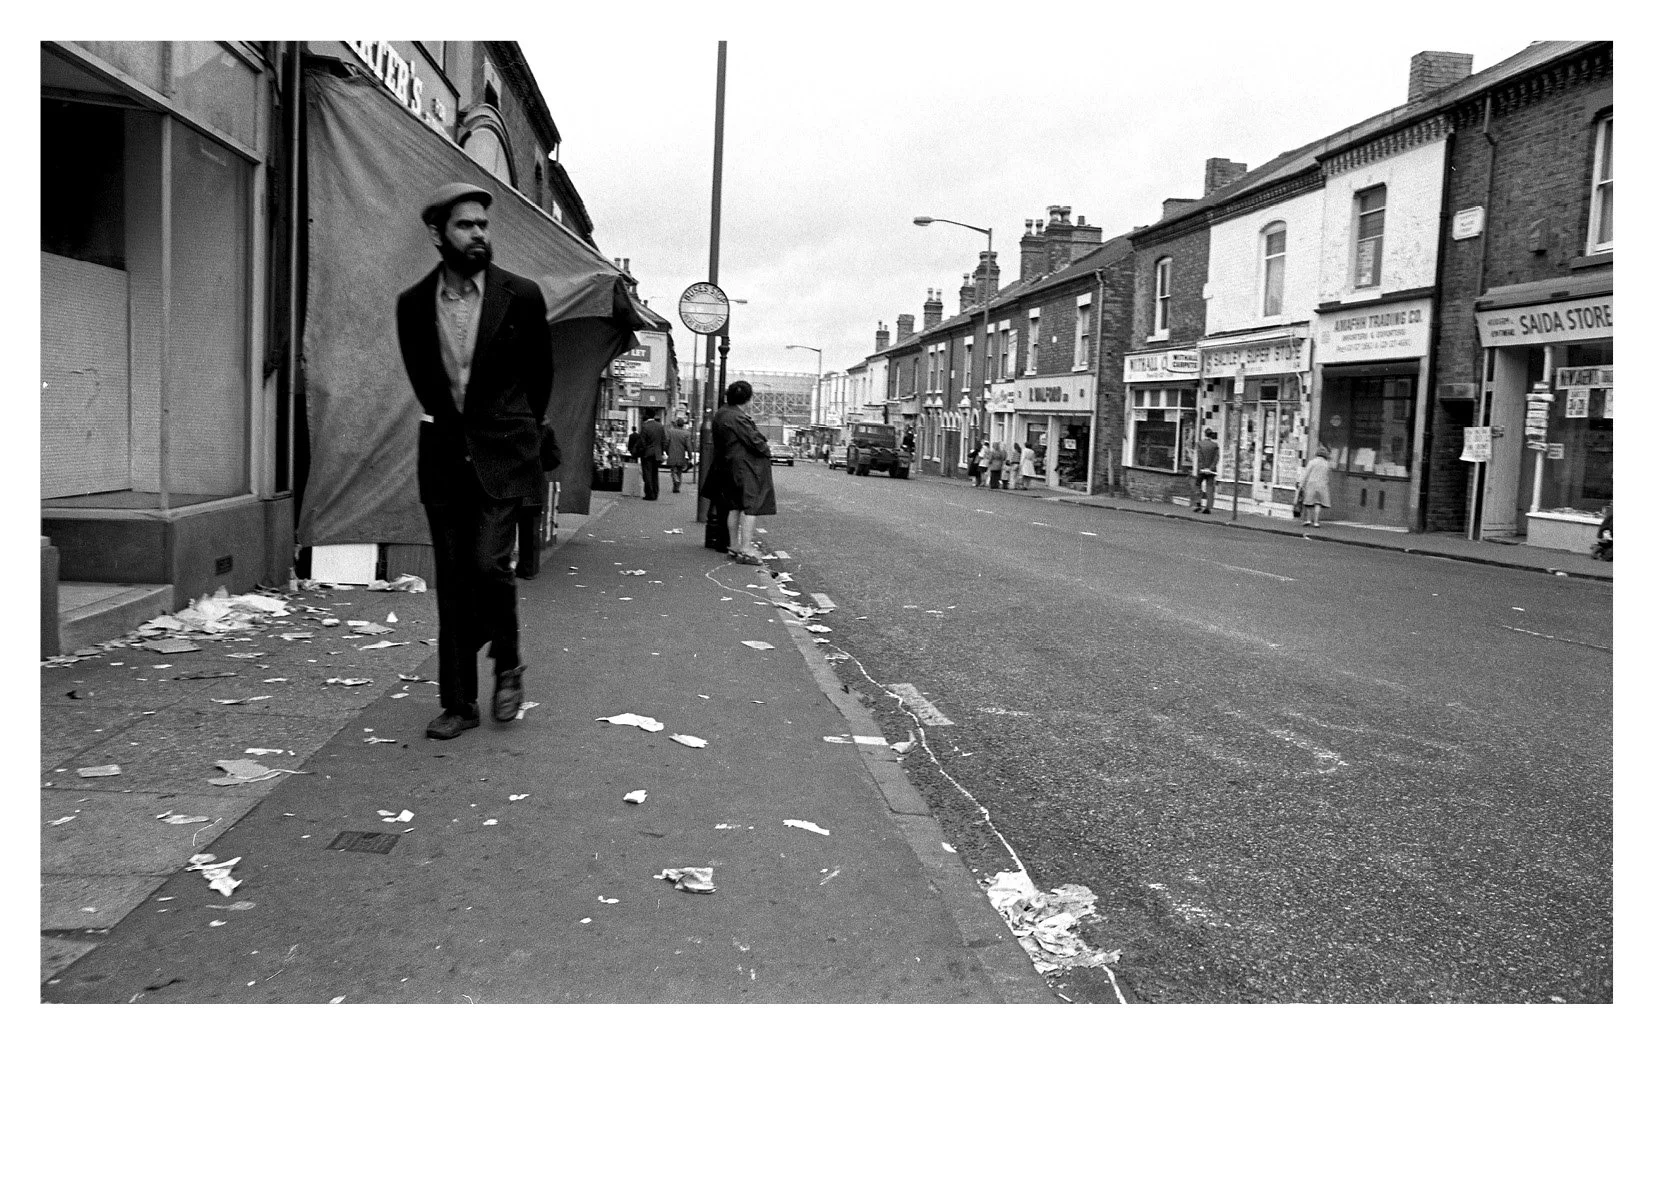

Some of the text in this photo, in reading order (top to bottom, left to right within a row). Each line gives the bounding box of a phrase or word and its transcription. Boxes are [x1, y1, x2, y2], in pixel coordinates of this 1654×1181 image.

[683, 284, 727, 304] BUSES STOP
[1368, 311, 1407, 328] TRADING
[1519, 311, 1565, 335] SAIDA
[631, 348, 647, 357] LET
[1246, 346, 1272, 364] SUPER
